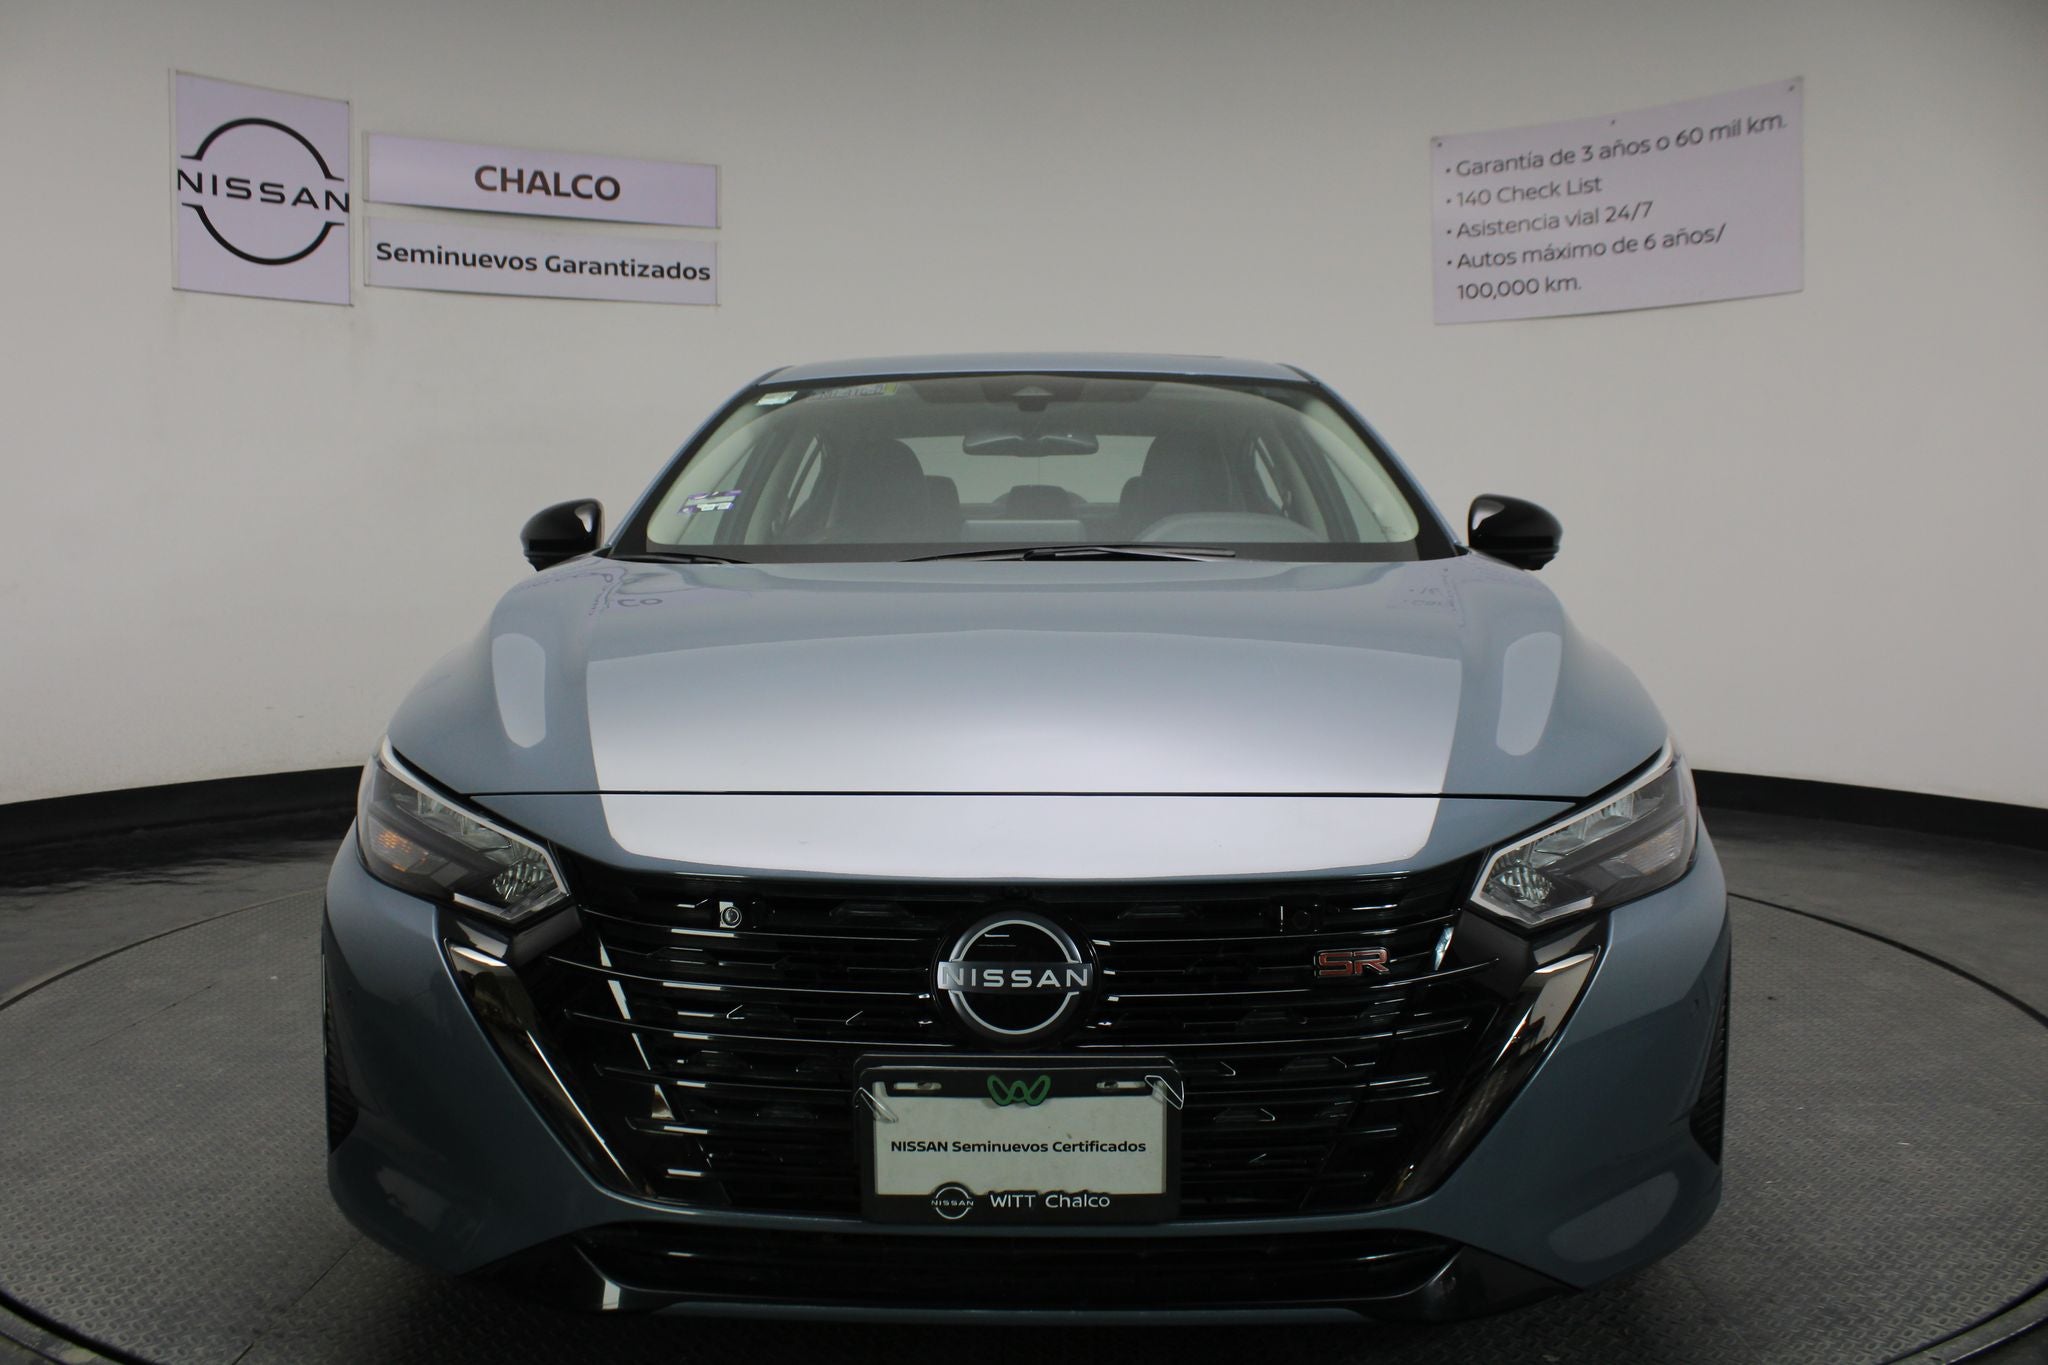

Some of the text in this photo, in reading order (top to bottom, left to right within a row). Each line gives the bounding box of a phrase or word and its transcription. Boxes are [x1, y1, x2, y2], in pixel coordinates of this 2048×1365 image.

[1456, 111, 1788, 177] Garantía de 3 años o 60 mil km.
[177, 168, 350, 213] NISSAN
[474, 165, 621, 201] CHALCO
[1457, 176, 1602, 207] 140 Check List
[1456, 201, 1653, 238] Asistencia vial 24/7
[376, 241, 711, 281] Seminuevos Garantizados
[1457, 223, 1726, 270] Autos máximo de 6 años/
[1457, 276, 1582, 301] 100,000 km.
[941, 966, 1089, 988] NISSAN
[1316, 947, 1391, 977] SR
[890, 1140, 1147, 1153] NISSAN Seminuevos Certificados
[990, 1192, 1111, 1208] WITT Chalco
